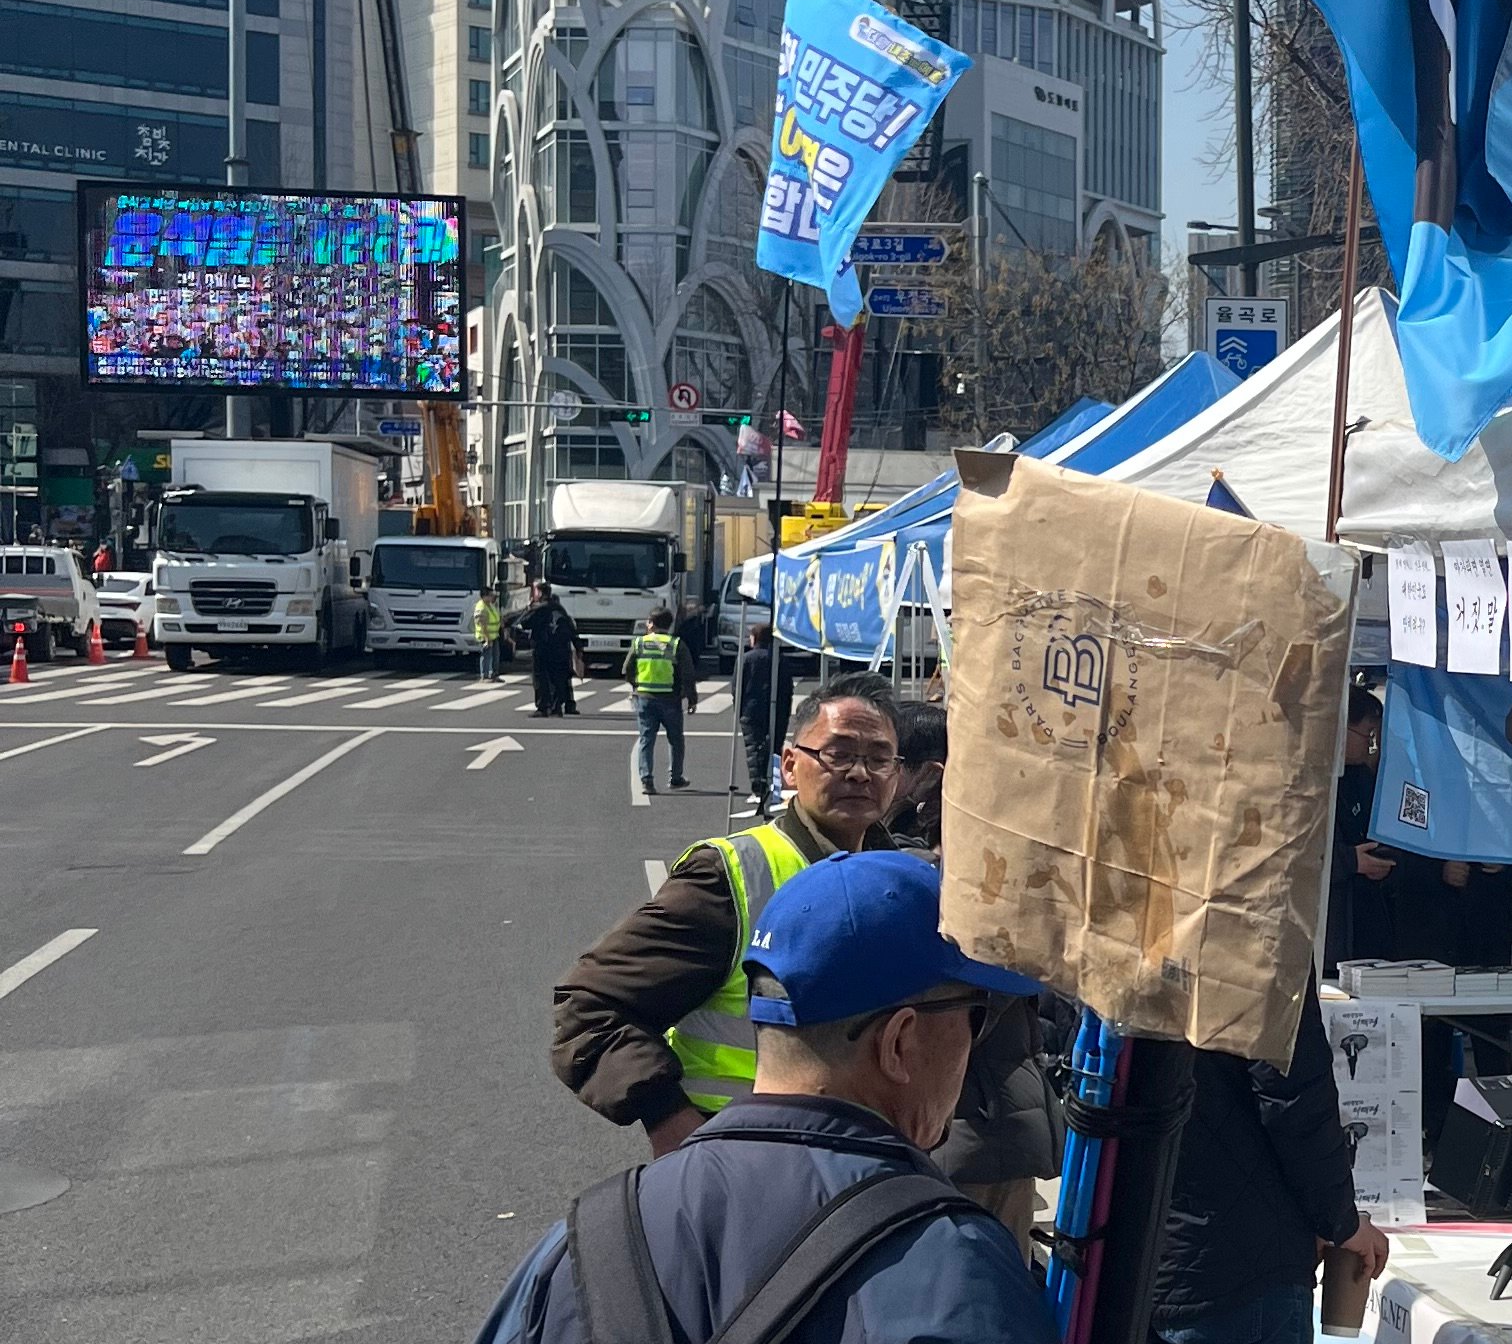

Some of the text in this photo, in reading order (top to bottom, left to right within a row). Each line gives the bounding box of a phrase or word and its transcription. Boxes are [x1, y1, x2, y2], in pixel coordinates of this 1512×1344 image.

[795, 48, 918, 149] 민주당!
[0, 139, 107, 161] ENTAL CLINIC
[856, 237, 904, 252] 곡로3길
[1216, 306, 1278, 324] 율곡로
[1015, 683, 1054, 738] PARIS
[751, 929, 772, 950] LA
